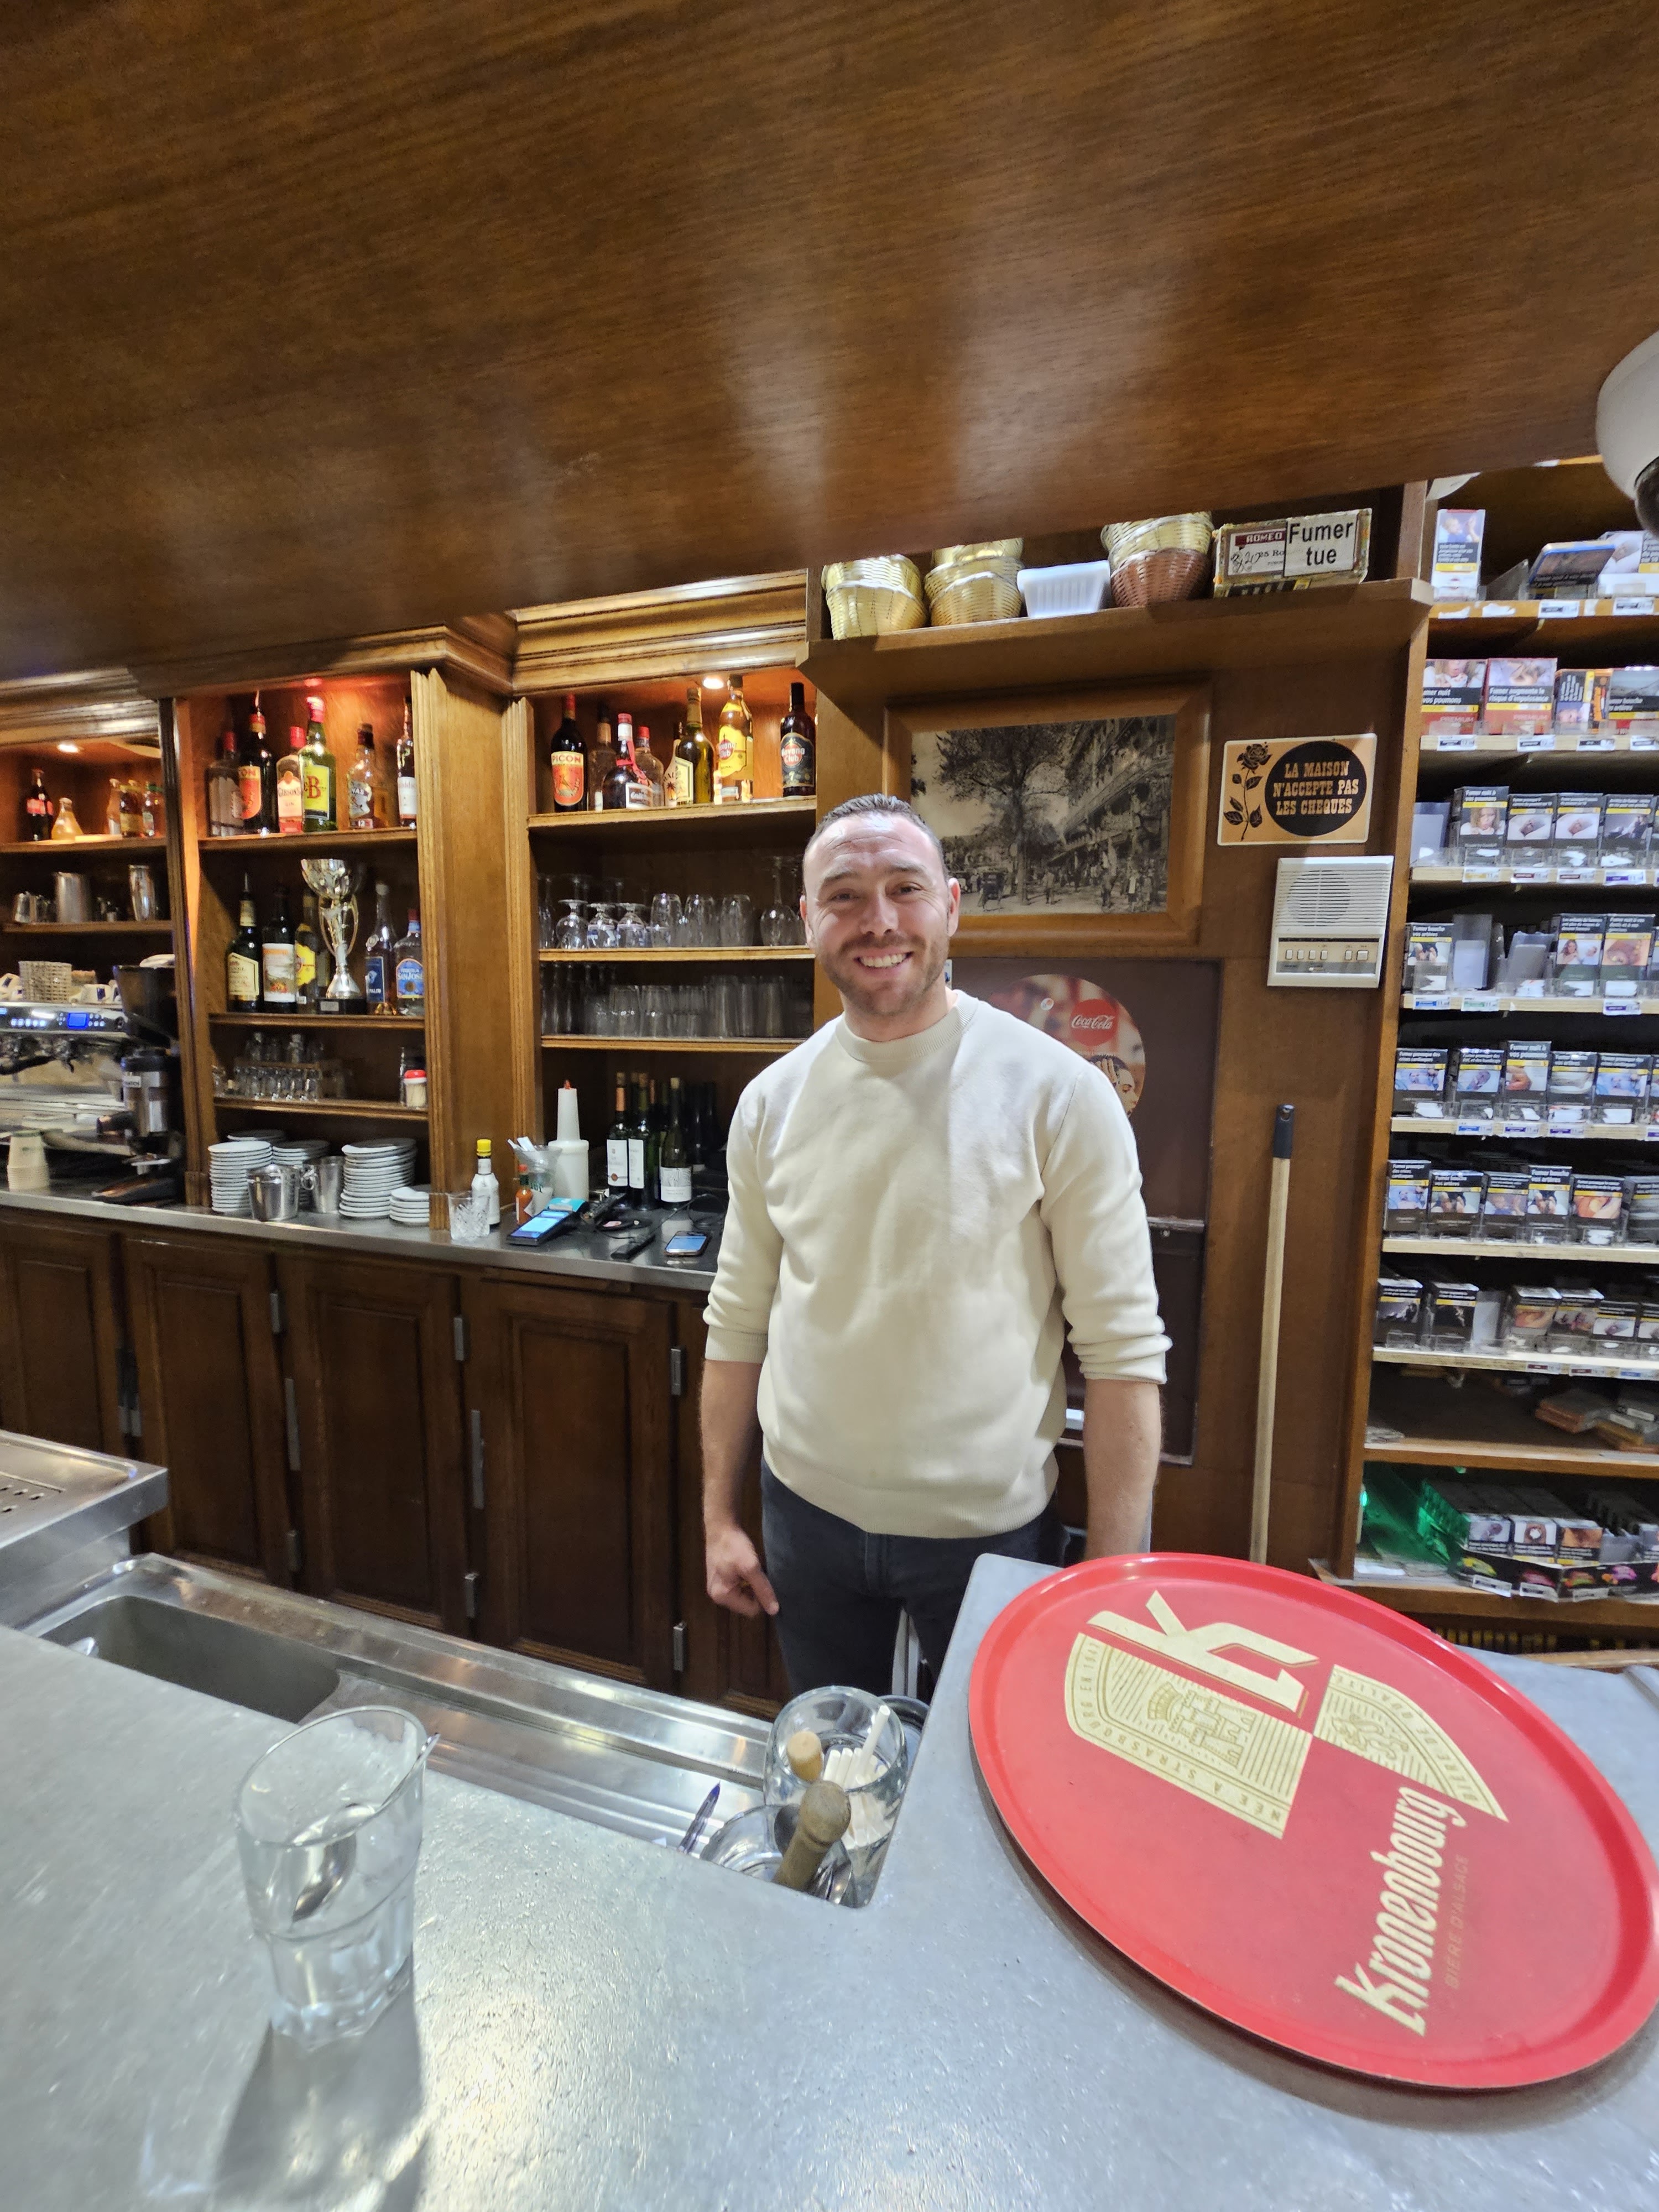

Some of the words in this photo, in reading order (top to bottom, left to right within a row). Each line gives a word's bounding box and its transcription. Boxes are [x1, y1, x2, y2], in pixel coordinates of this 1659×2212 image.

[1246, 531, 1283, 544] ROMEO
[1288, 521, 1354, 544] Fumer
[1306, 546, 1337, 566] tue
[552, 754, 581, 764] PICON
[1284, 762, 1299, 779] LA
[1303, 760, 1350, 778] MAISON
[1273, 780, 1334, 797] N'ACCEPTE
[1337, 779, 1359, 795] PAS
[1276, 800, 1297, 816] LES
[1301, 798, 1353, 816] CHEQUES
[1071, 1014, 1115, 1030] Coca-Cola
[1333, 1786, 1468, 2037] Kronenbourg
